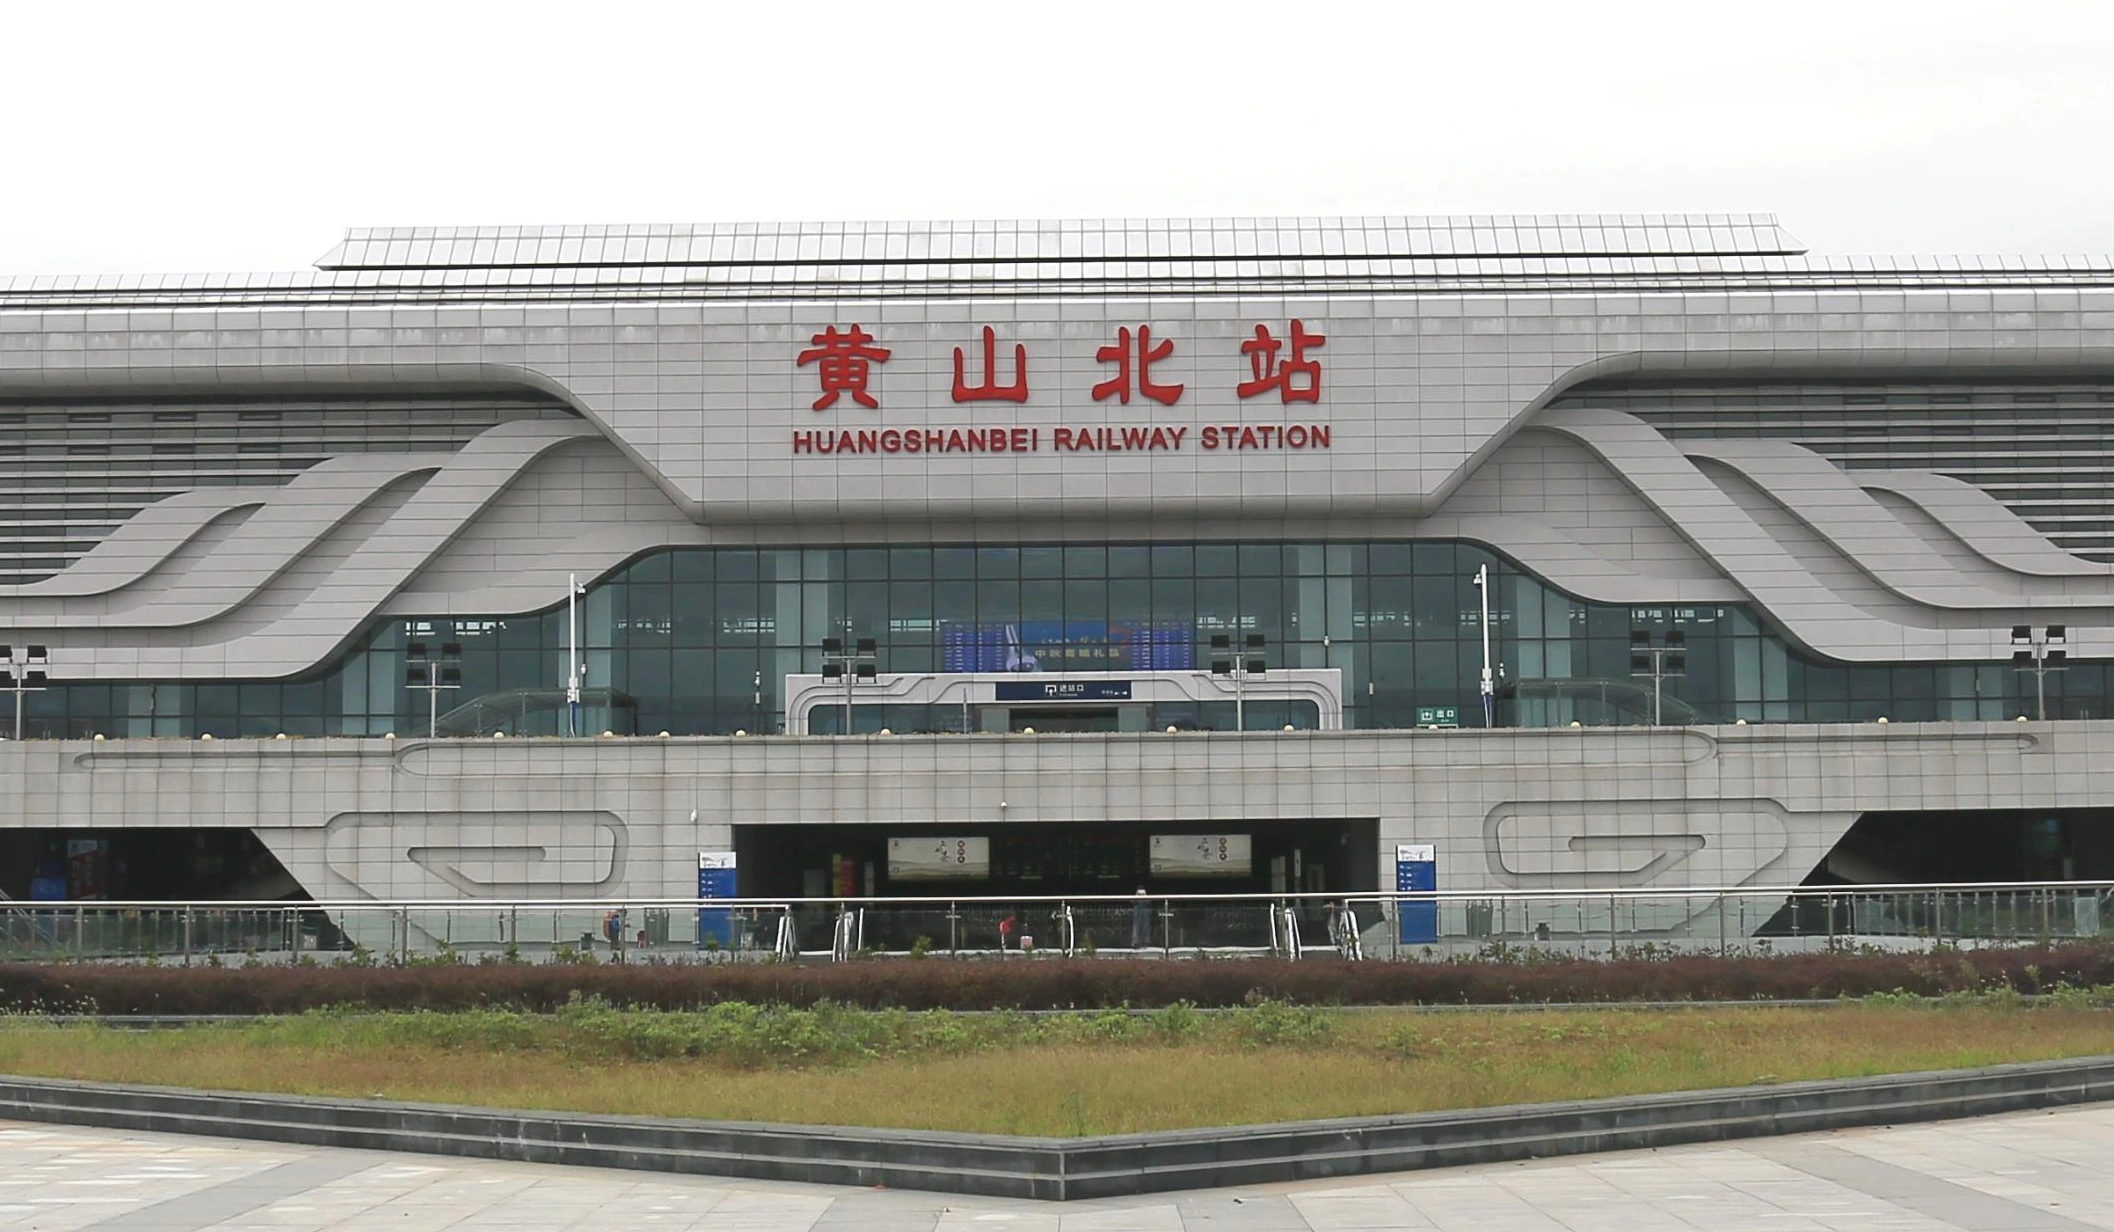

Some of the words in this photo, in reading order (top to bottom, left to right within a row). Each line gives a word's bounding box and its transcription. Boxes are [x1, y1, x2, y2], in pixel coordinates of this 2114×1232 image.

[797, 319, 1326, 411] 黄山北站
[793, 430, 1038, 454] HUANGSHANBEI
[1054, 427, 1187, 452] RAILWAY
[1202, 425, 1330, 450] STATION
[1059, 684, 1084, 692] 进站口
